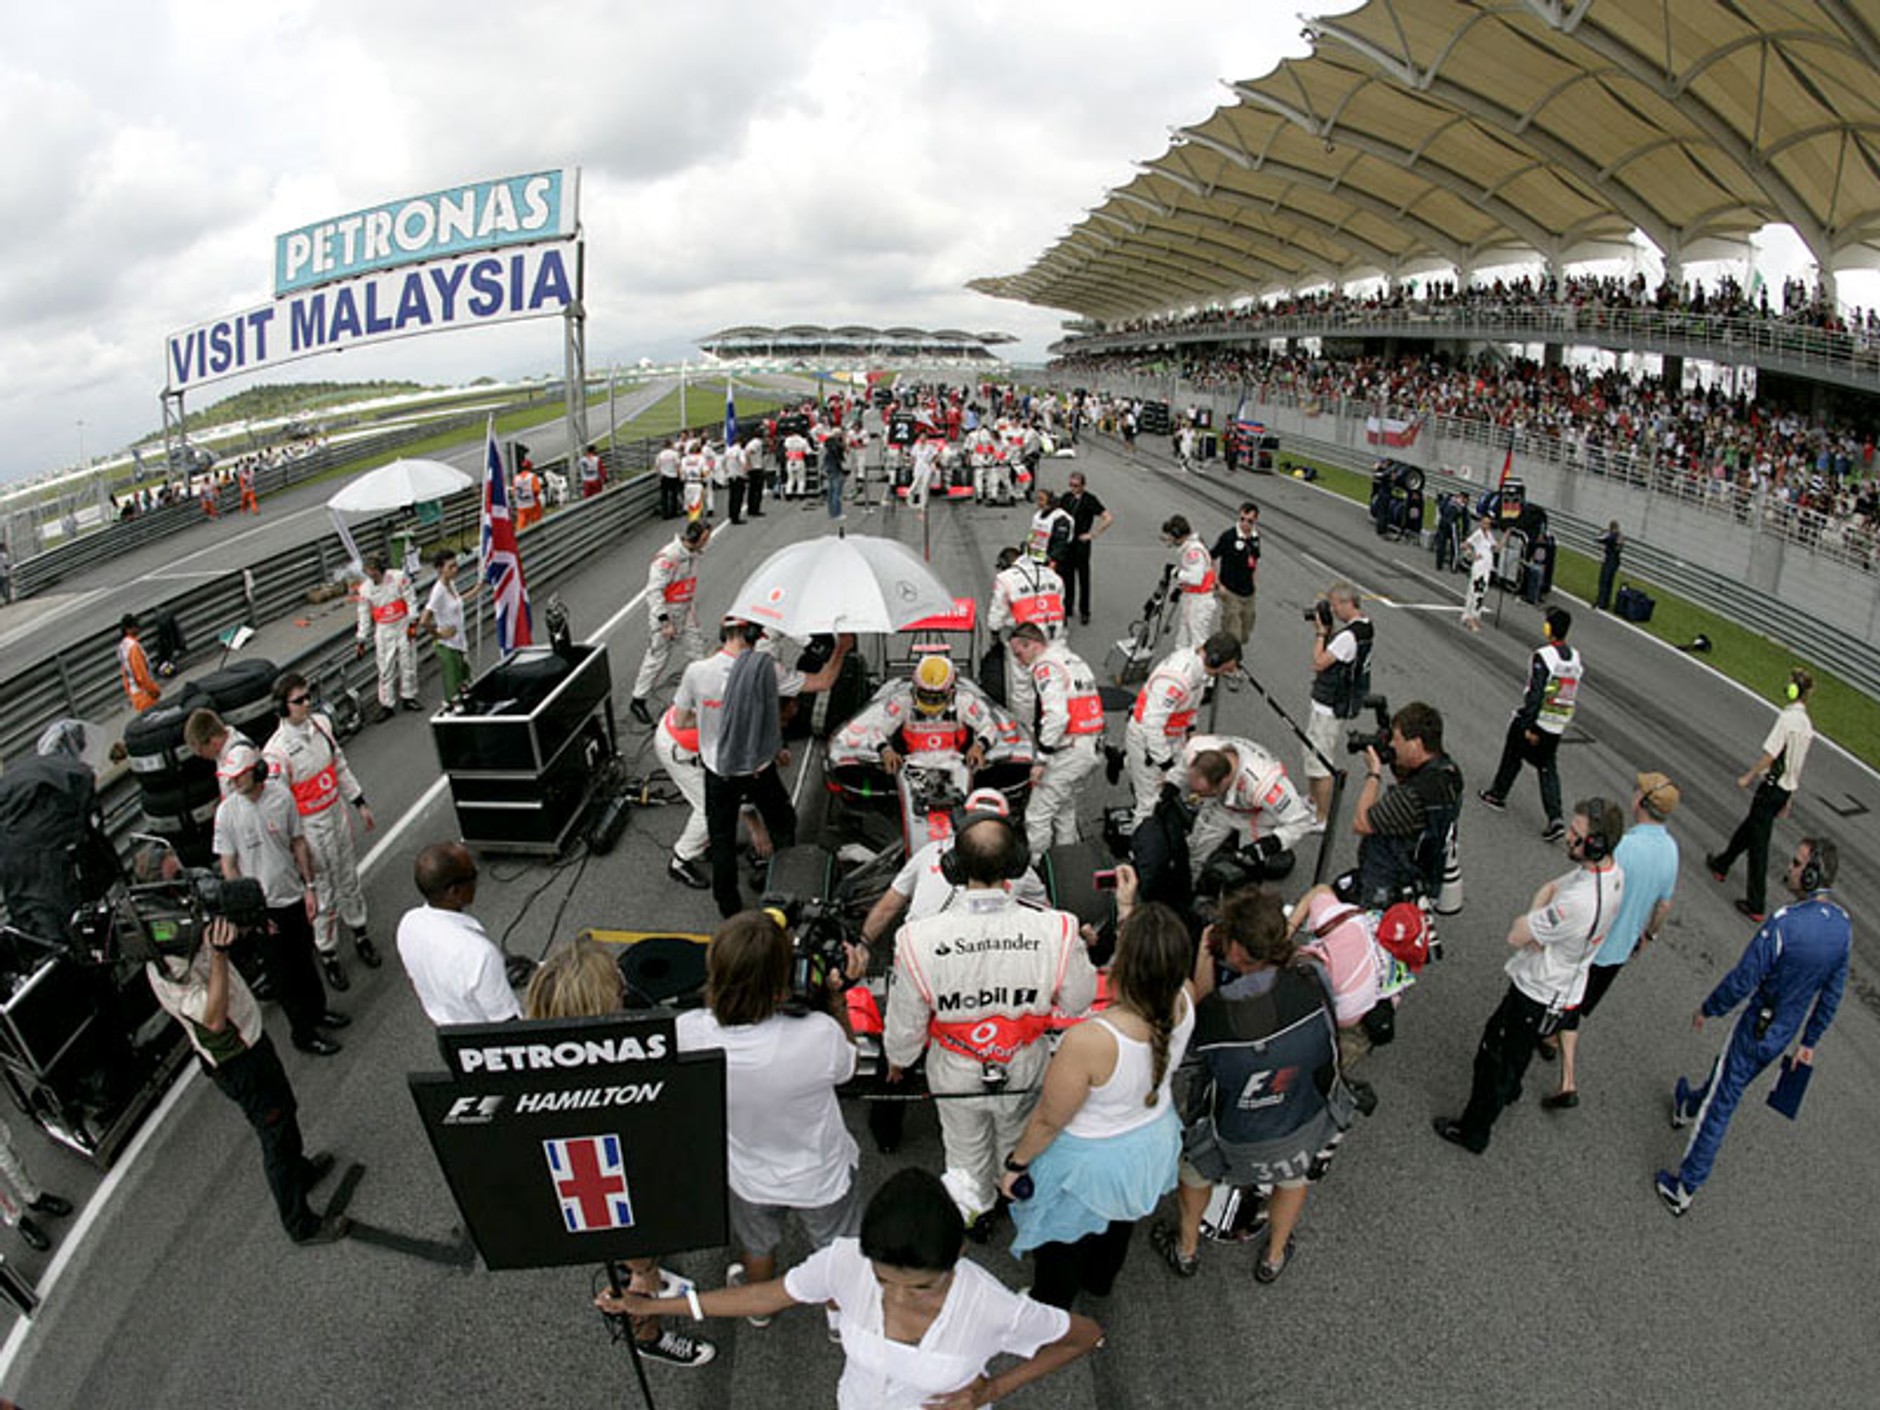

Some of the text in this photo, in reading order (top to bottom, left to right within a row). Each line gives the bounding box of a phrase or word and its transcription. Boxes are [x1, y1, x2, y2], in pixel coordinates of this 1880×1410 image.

[285, 176, 552, 282] PETRONAS
[171, 248, 574, 385] VISIT MALAYSIA
[955, 933, 1041, 955] Santander
[937, 987, 1008, 1011] Mobil
[458, 1033, 667, 1073] PETRONAS
[445, 1081, 665, 1118] F1 HAMILTON
[1240, 1066, 1299, 1099] F1
